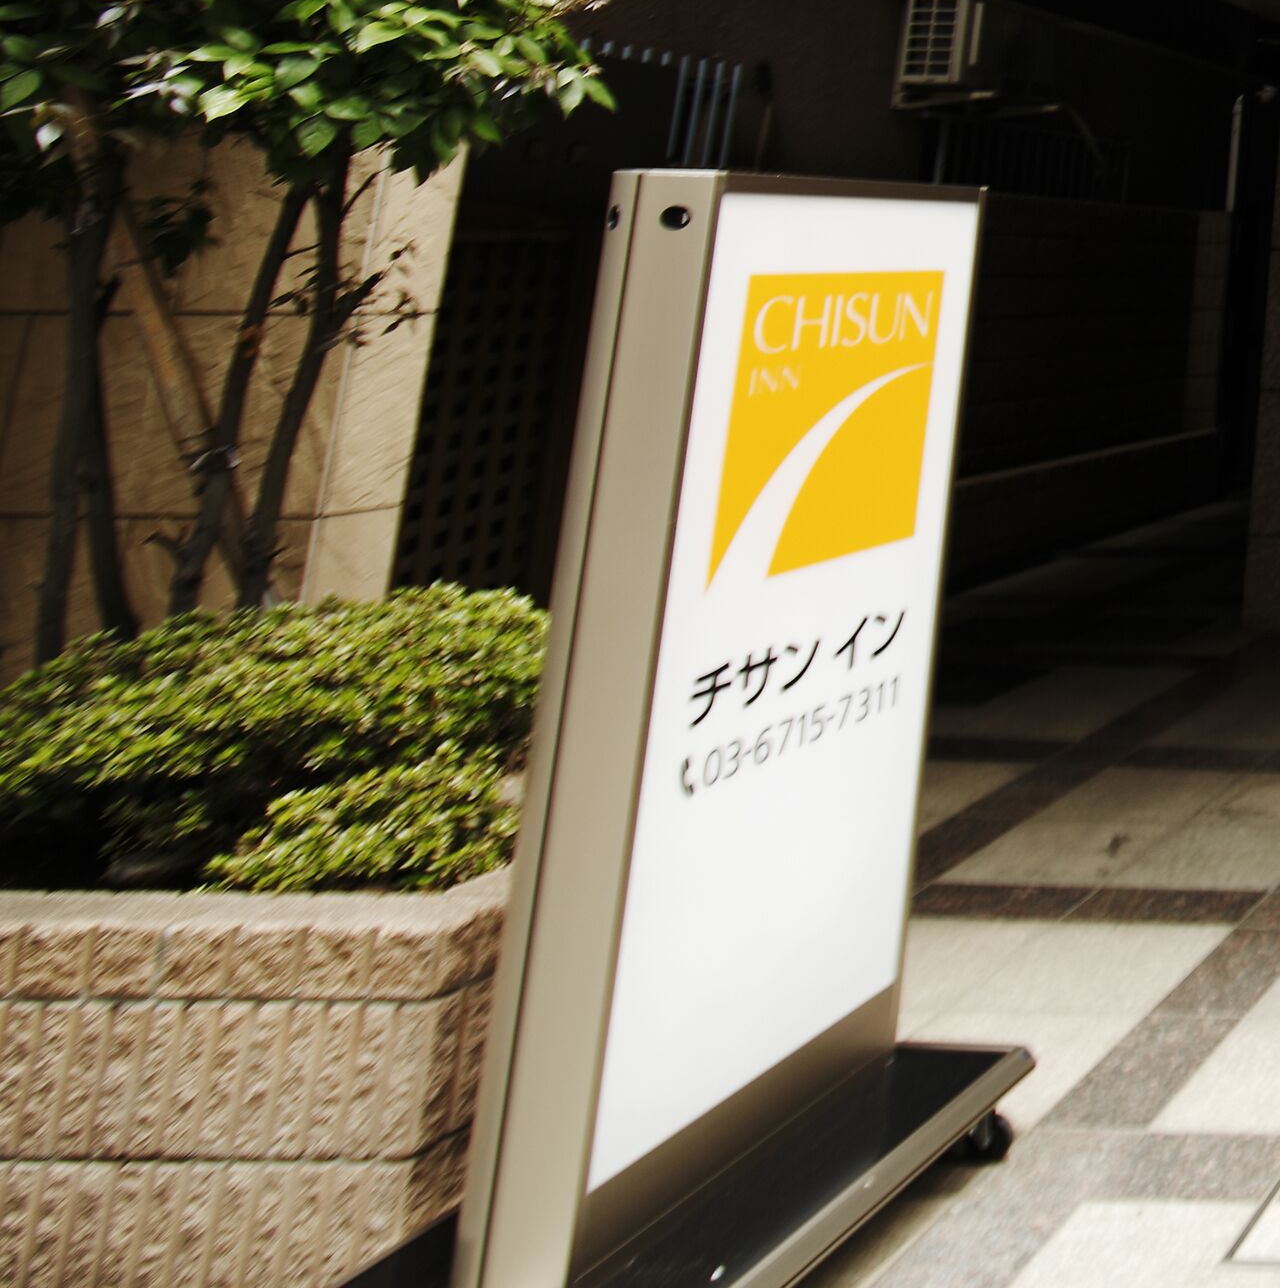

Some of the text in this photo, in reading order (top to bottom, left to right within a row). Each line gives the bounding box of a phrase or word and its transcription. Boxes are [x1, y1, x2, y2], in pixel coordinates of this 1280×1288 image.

[752, 289, 934, 356] CHISUN
[748, 363, 802, 399] INN
[689, 610, 906, 729] チサン イン
[703, 673, 903, 787] 03-6715-7311
